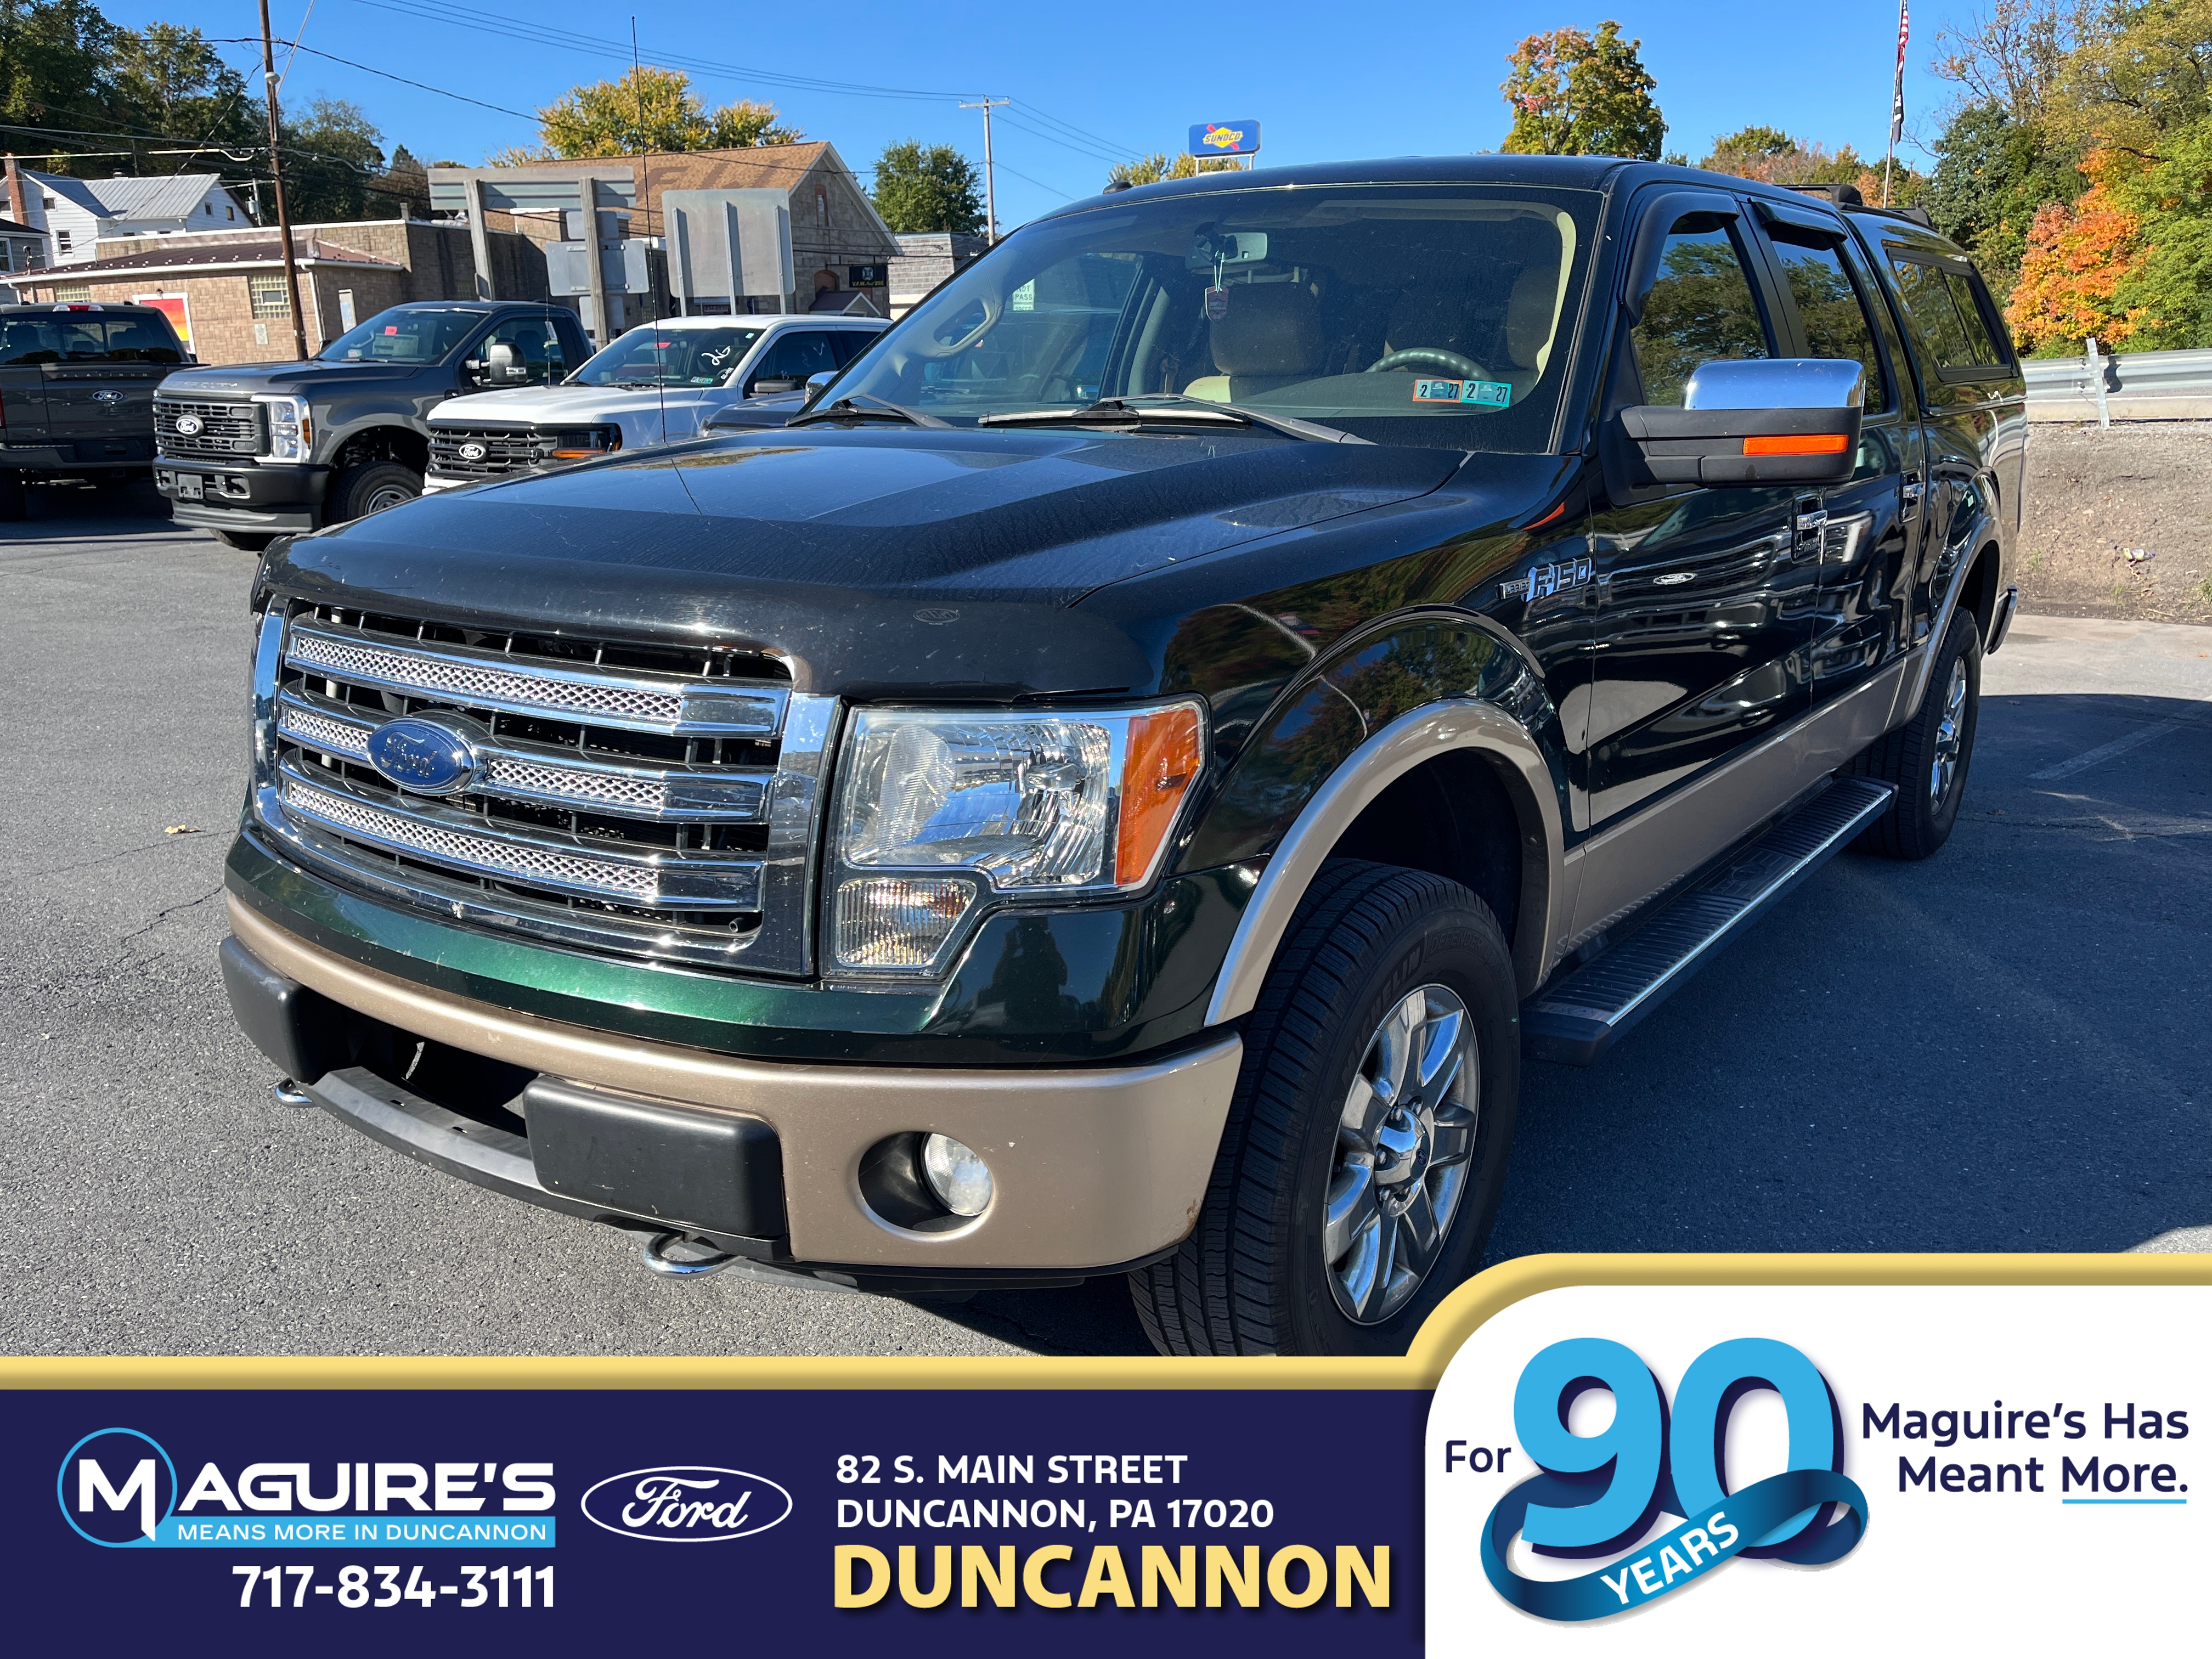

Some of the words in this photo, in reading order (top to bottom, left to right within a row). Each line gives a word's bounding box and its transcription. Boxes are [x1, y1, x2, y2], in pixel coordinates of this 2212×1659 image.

[1205, 132, 1240, 143] SUNOCO
[1420, 384, 1427, 397] 2
[1447, 383, 1459, 400] 27
[1466, 383, 1476, 399] 2
[1496, 386, 1508, 404] 27
[380, 731, 438, 778] Ford
[1341, 948, 1422, 1084] MICHELIN
[1430, 929, 1483, 955] DEFENDER
